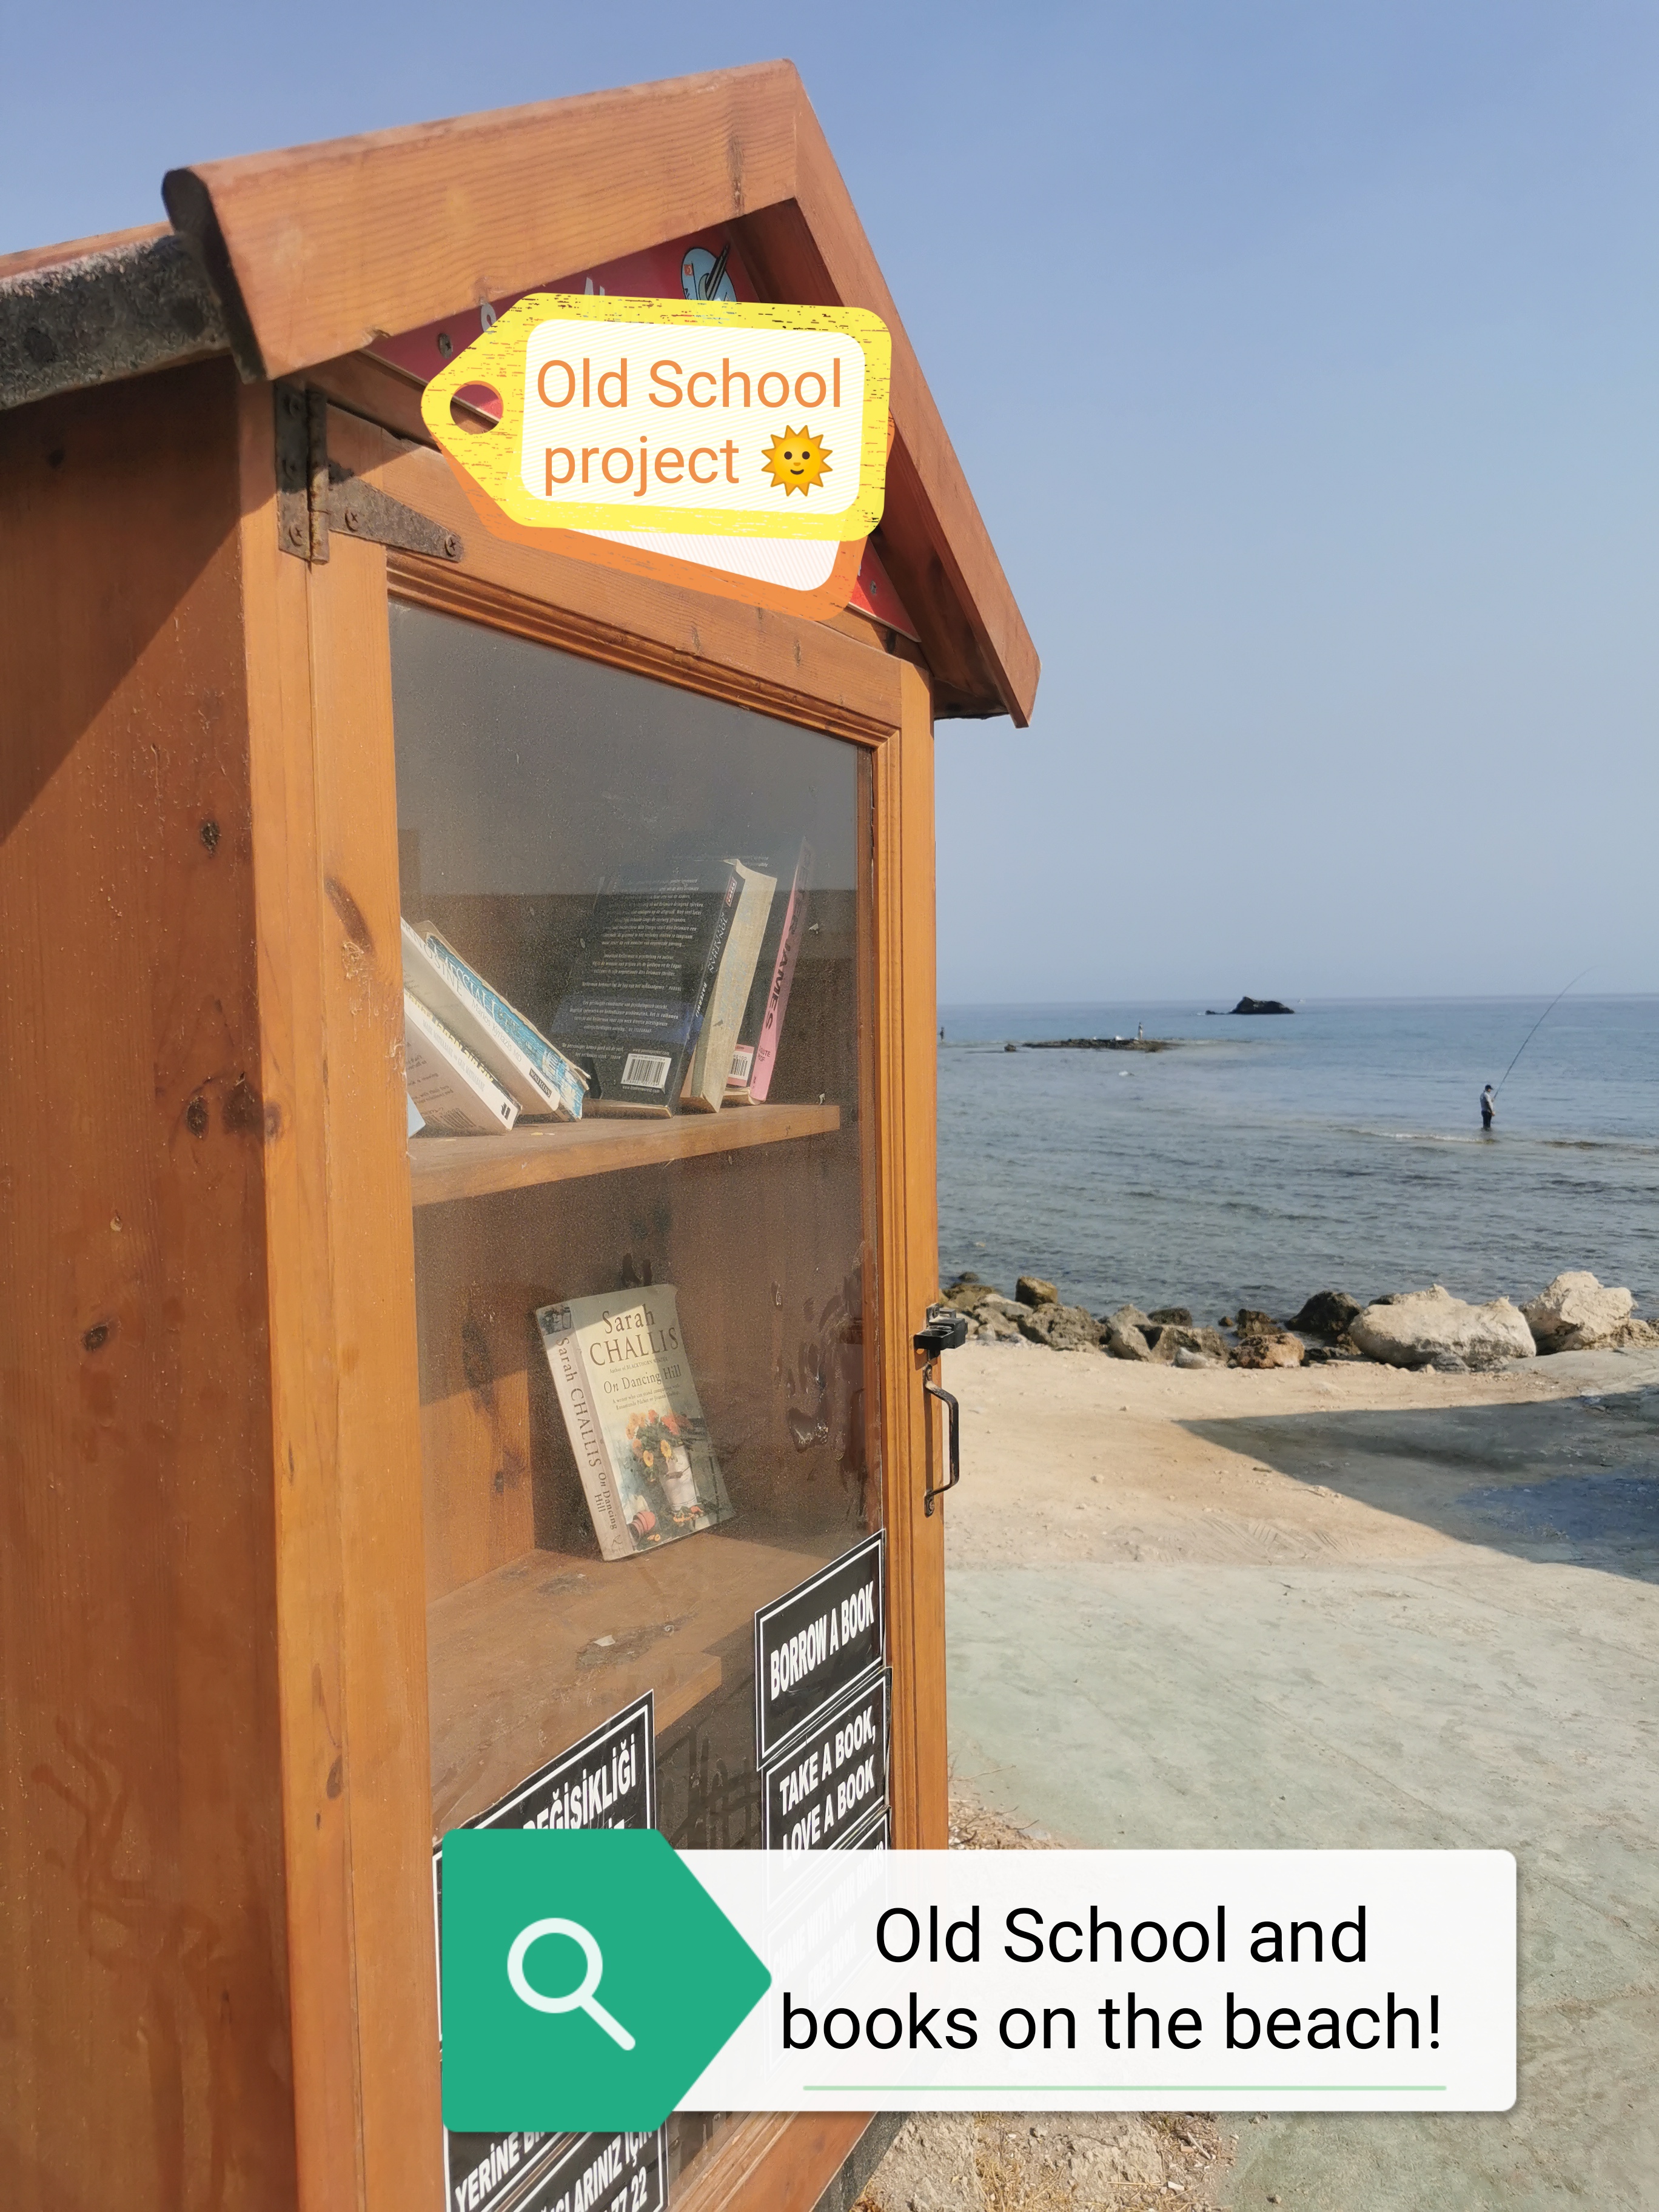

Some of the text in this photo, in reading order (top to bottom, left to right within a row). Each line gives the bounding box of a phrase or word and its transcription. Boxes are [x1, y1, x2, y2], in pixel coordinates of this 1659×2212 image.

[708, 916, 728, 973] JONATHAN
[472, 999, 491, 1027] Marios
[492, 1024, 512, 1051] Kyriazis
[530, 1070, 552, 1097] WATKINS
[602, 1304, 655, 1334] Sarah
[589, 1327, 679, 1366] CHALLIS
[556, 1337, 602, 1468] Sarah CHALLIS
[604, 1364, 682, 1393] On Dancing Hill
[594, 1493, 606, 1513] Hill
[598, 1472, 617, 1530] On Dancing
[771, 1580, 874, 1701] BORROW A BOOK
[780, 1705, 876, 1816] TAKE A BOOK,
[783, 1754, 874, 1872] LOVE A BOOK
